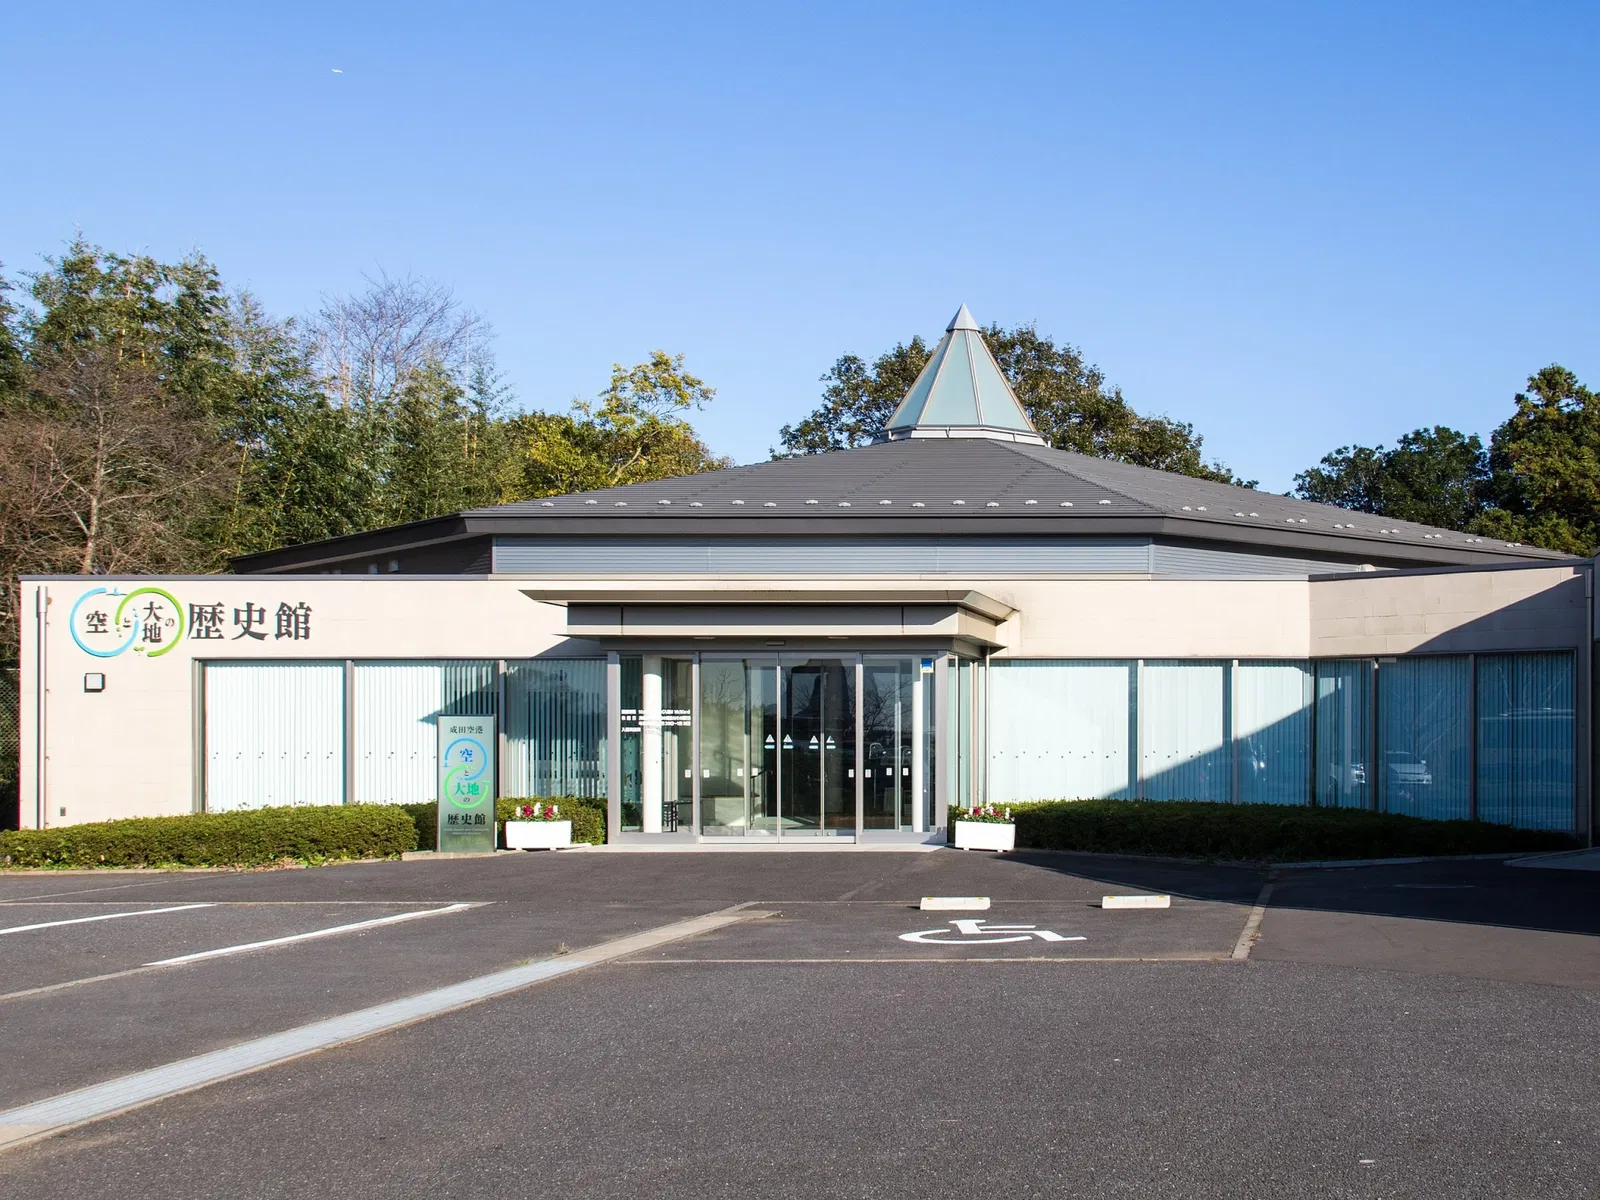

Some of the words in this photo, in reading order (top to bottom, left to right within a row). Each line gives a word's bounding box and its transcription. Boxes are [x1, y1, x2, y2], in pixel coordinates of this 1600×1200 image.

[187, 601, 312, 641] 歴史館
[449, 725, 484, 734] 成田空港
[459, 748, 474, 763] 空
[454, 782, 480, 796] 大地
[447, 813, 486, 825] 歴史館
